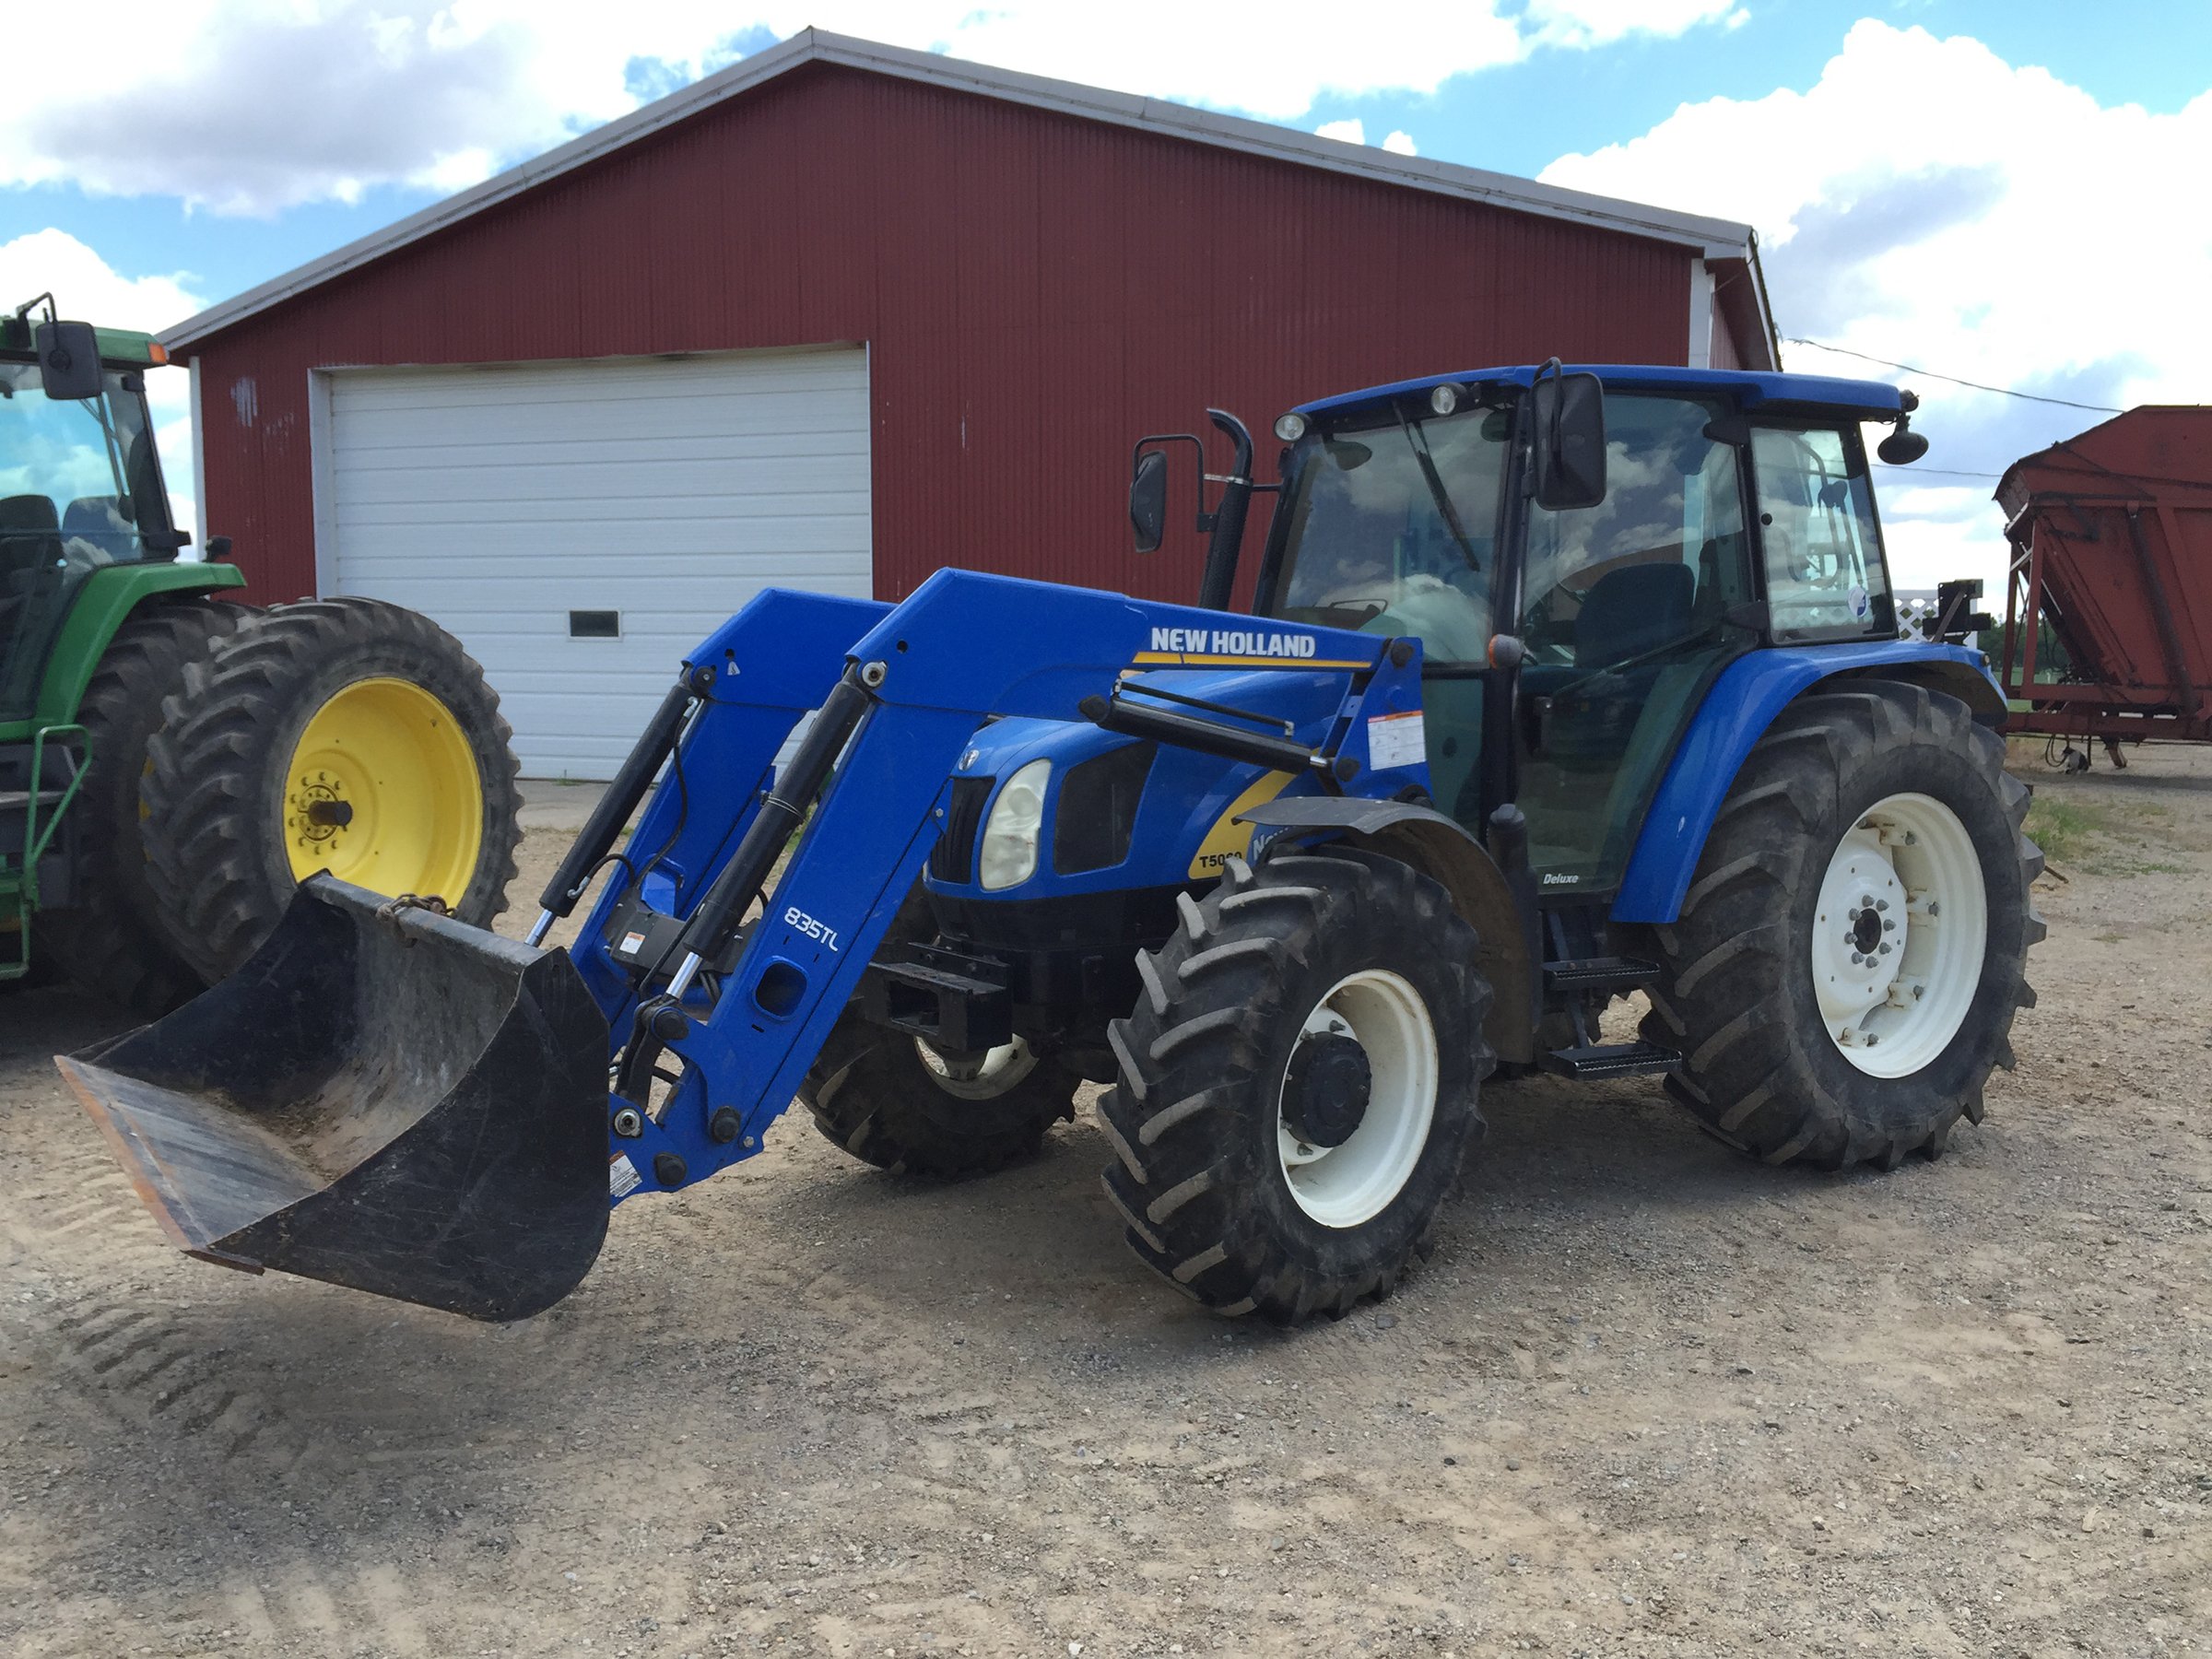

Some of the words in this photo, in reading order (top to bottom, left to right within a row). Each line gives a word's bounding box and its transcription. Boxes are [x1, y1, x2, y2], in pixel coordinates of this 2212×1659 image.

[1152, 628, 1207, 653] NEW
[1212, 631, 1315, 657] HOLLAND
[1543, 873, 1579, 885] Deluxe
[784, 907, 838, 951] 835TL
